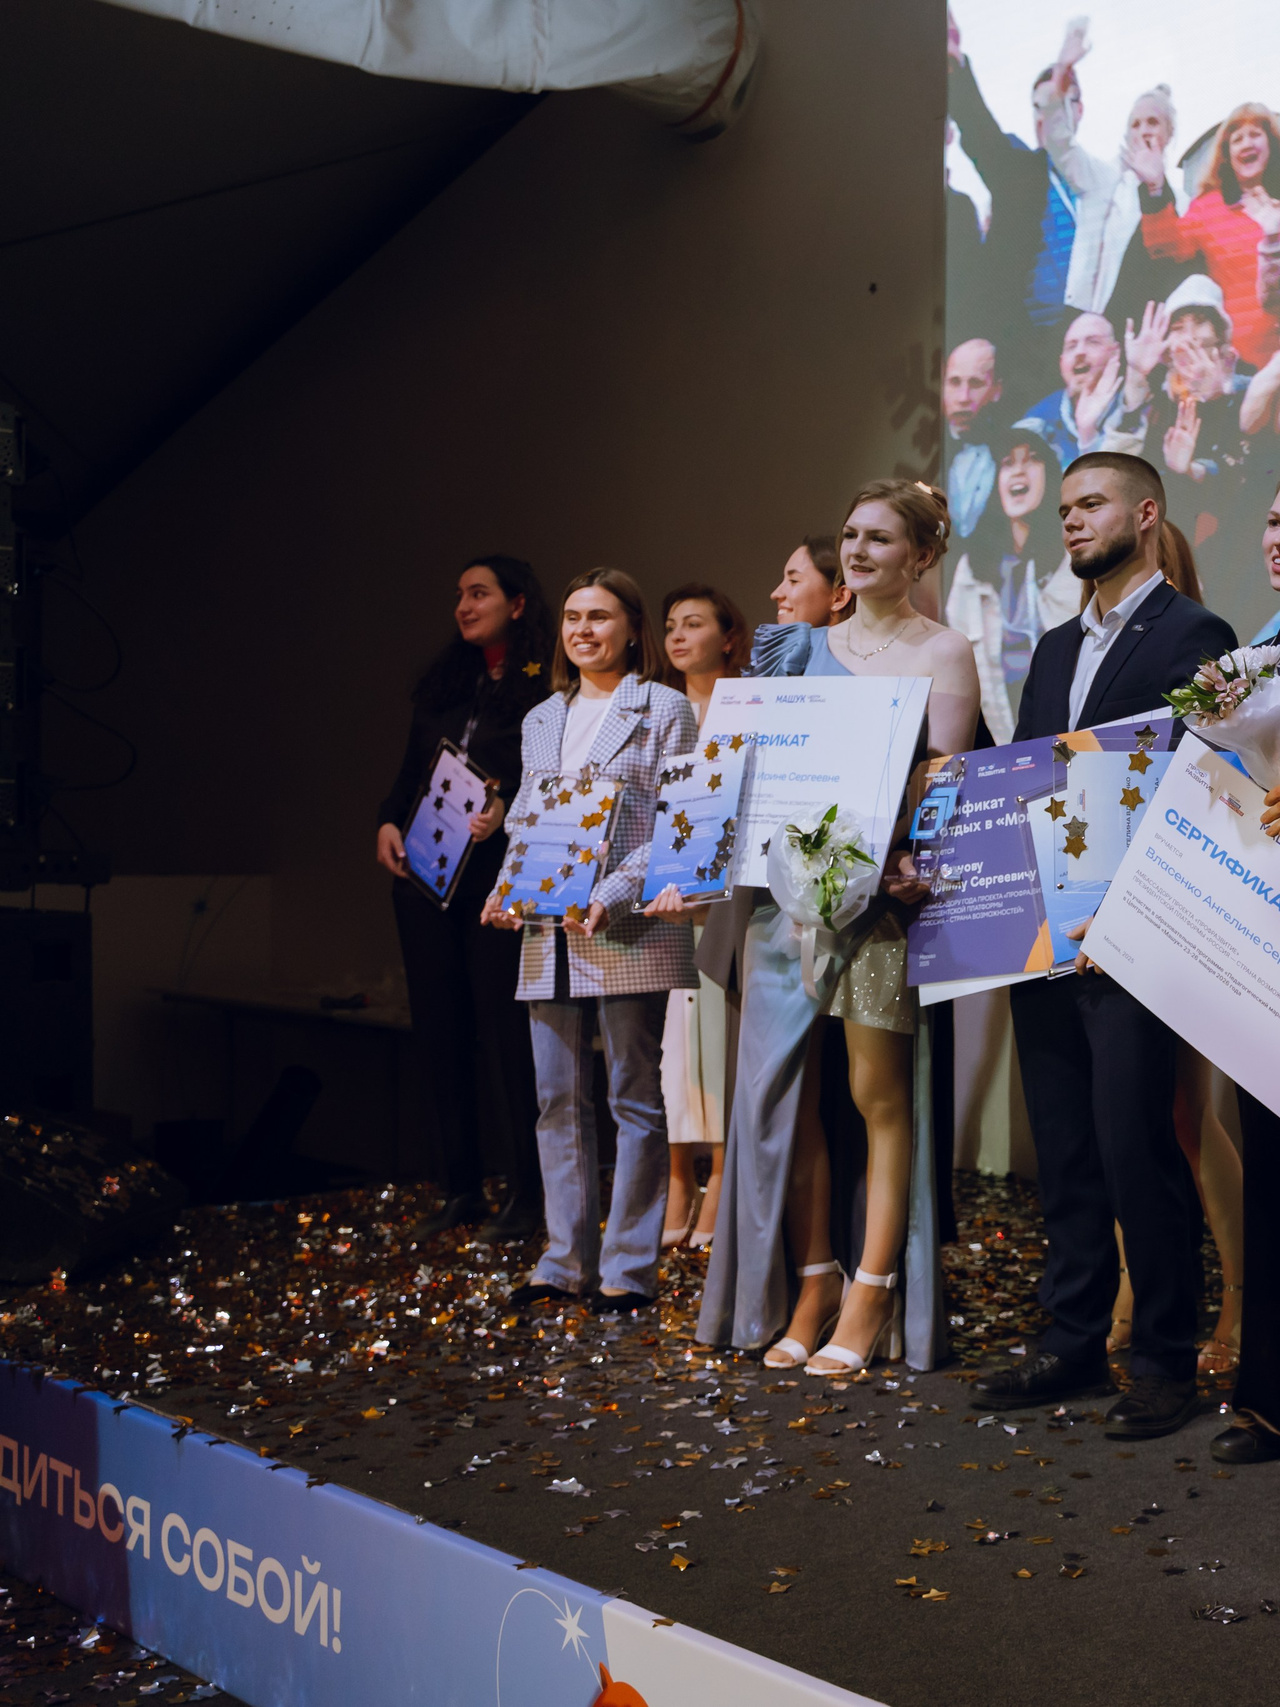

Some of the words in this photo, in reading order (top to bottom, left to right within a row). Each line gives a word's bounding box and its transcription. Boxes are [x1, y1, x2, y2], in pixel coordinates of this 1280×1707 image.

[775, 694, 807, 704] МАШУК
[710, 733, 810, 747] СЕРИФИКАТ
[757, 771, 786, 782] Ирине
[788, 772, 840, 783] Сергеевне
[978, 767, 1006, 777] РАЗВИТИЕ
[1188, 763, 1208, 778] ПРОФ
[1185, 768, 1214, 793] РАЗВИТИЕ
[921, 798, 1005, 821] Сеификат
[939, 822, 981, 838] отдых
[985, 820, 993, 830] в
[1154, 833, 1184, 859] ВРУЧАЕТСЯ
[970, 870, 1037, 889] Сергеевичу
[977, 894, 1003, 903] ПРОЕКТА
[1146, 847, 1202, 898] Власенко
[1202, 895, 1261, 946] Ангелине
[949, 914, 972, 923] СТРАНА
[972, 907, 1024, 919] ВОЗМОЖНОСТЕЙ»
[966, 902, 1003, 912] ПЛАТФОРМЫ
[1136, 869, 1172, 900] АМБАССАДОРУ
[1172, 899, 1195, 921] ПРОЕКТА
[1195, 919, 1239, 956] «ПРОФРАЗВИТИЕ»
[1133, 875, 1174, 912] ПРЕЗИДЕНТСКОЙ
[1174, 910, 1206, 938] ПЛАТФОРМЫ
[1206, 937, 1231, 959] «РОССИЯ
[1236, 960, 1257, 980] СТРАНА
[1126, 899, 1145, 917] Центре
[1144, 914, 1161, 930] знаний
[1161, 928, 1184, 949] «Машук»
[1198, 959, 1216, 977] января
[1230, 983, 1242, 998] года
[1132, 894, 1152, 914] участие
[1155, 913, 1197, 951] образовательной
[1196, 947, 1224, 973] программе
[1224, 970, 1269, 1009] «Педагогический
[0, 1433, 151, 1560] ДИТЬСЯ
[161, 1512, 342, 1654] СОБОЙ!
